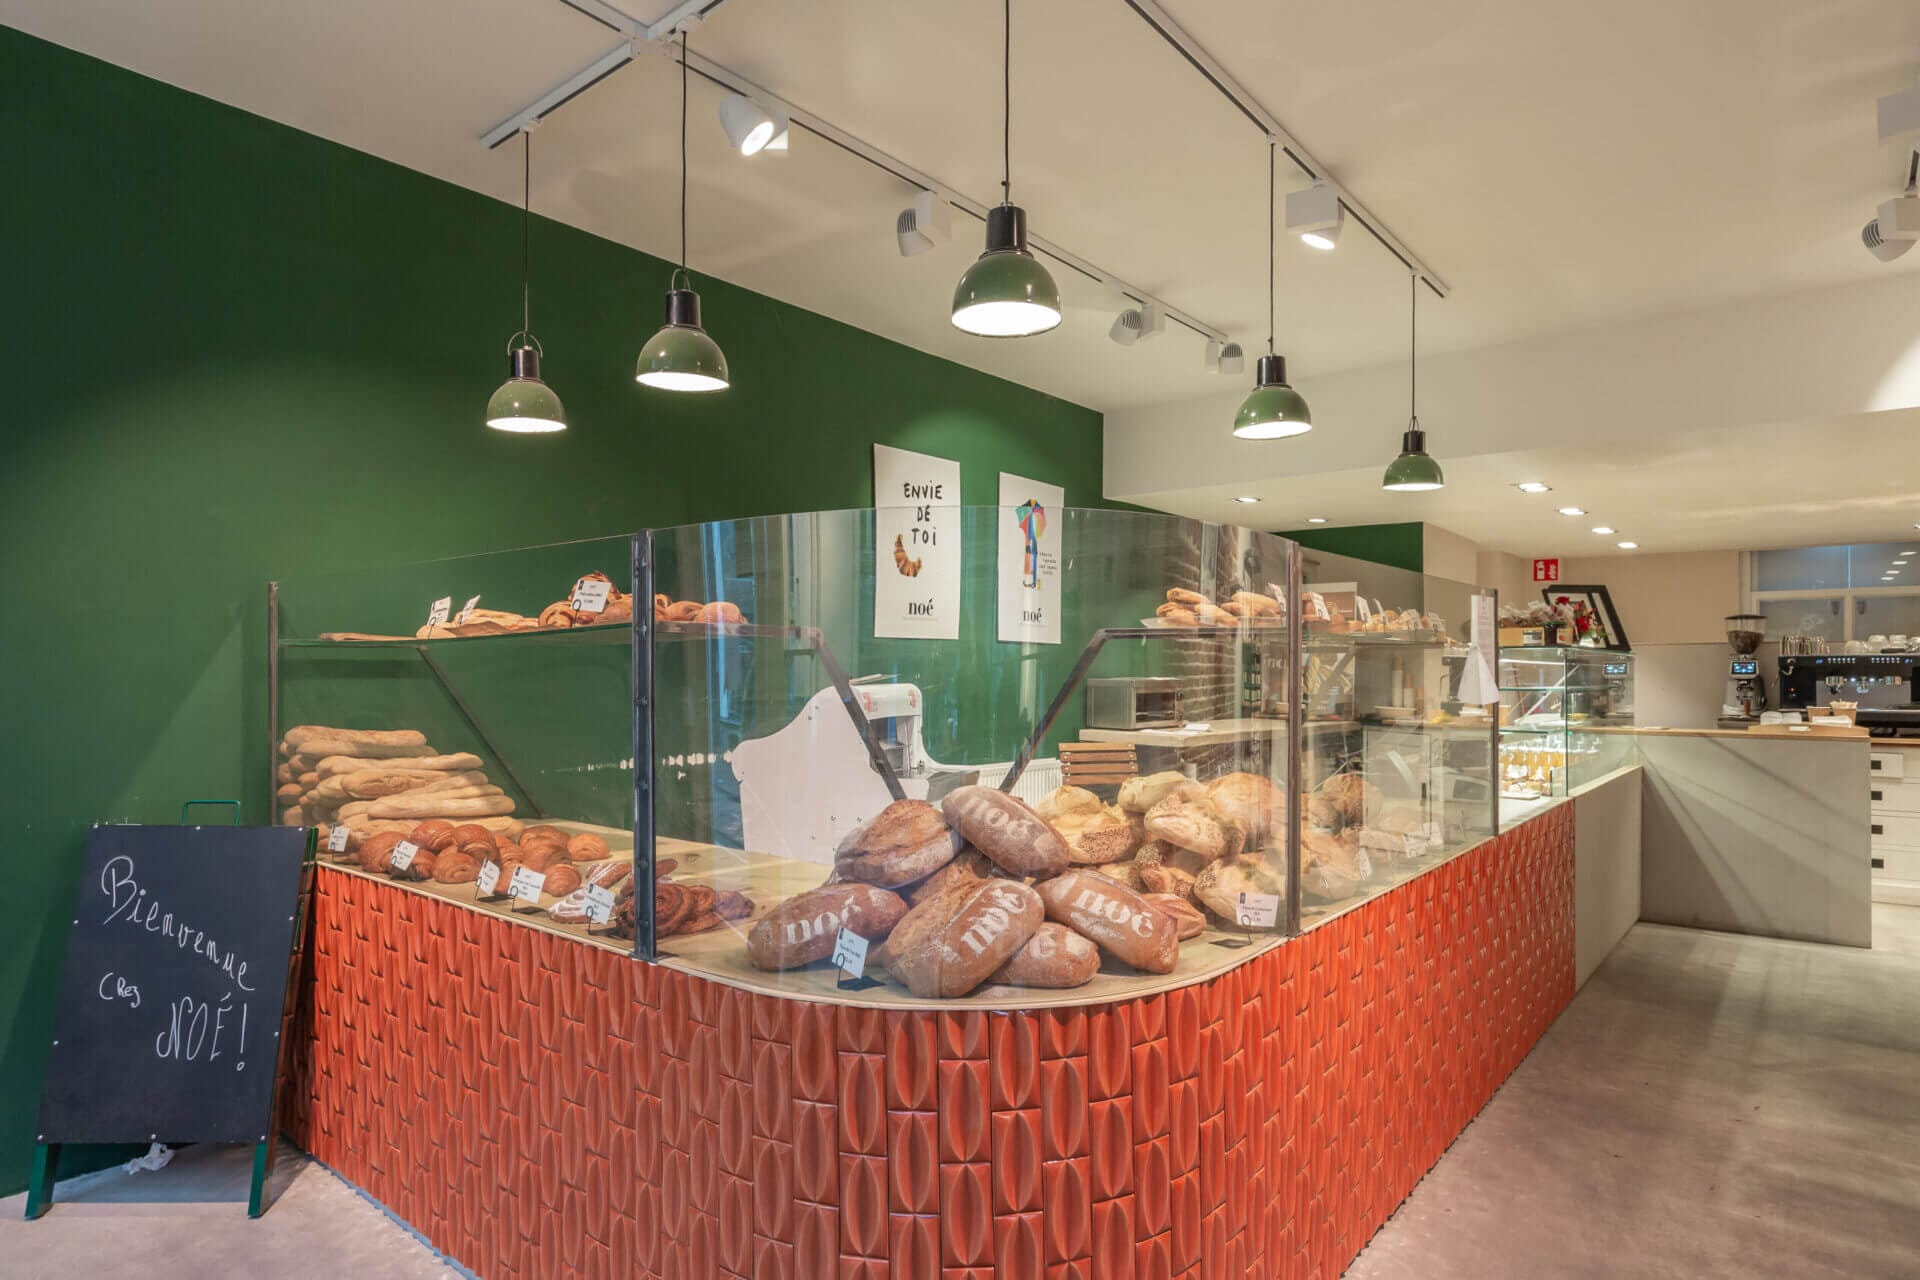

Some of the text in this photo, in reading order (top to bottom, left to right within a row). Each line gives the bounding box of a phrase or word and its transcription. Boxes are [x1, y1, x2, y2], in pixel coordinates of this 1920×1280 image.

[917, 504, 931, 522] DE
[908, 597, 934, 616] noé
[1022, 606, 1043, 624] noé
[101, 855, 255, 991] Bienvenue
[960, 887, 1026, 955] noé
[1071, 889, 1154, 938] noé
[99, 972, 141, 1008] Chez
